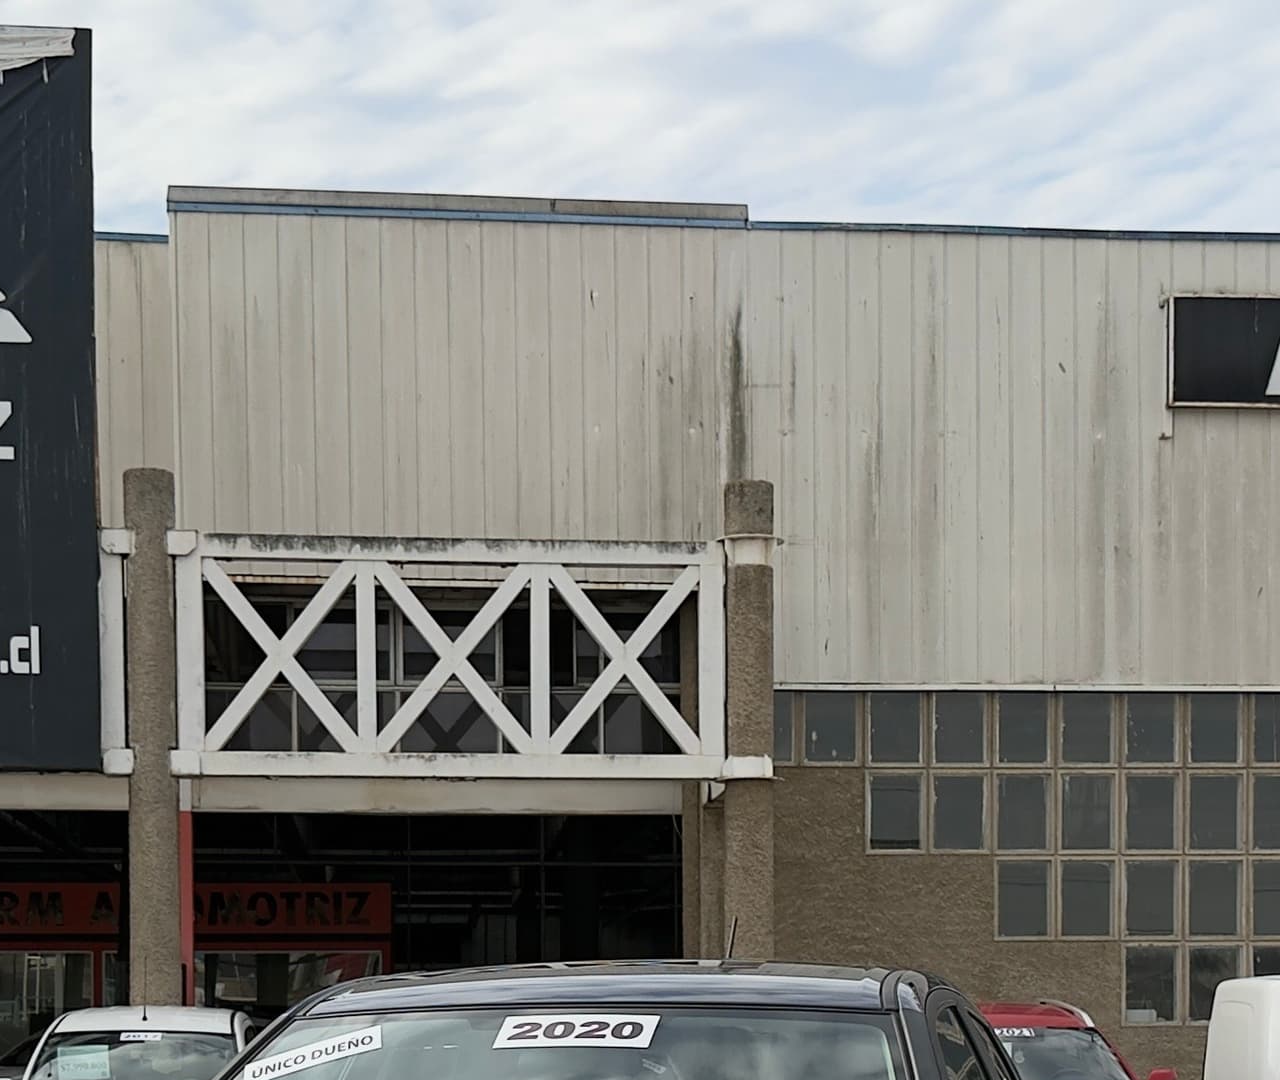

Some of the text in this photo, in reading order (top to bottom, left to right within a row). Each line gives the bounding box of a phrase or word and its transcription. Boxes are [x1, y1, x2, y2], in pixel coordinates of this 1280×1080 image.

[91, 891, 371, 927] AMOTRIZ
[506, 1021, 644, 1041] 2020
[311, 1034, 374, 1061] DUEÑO
